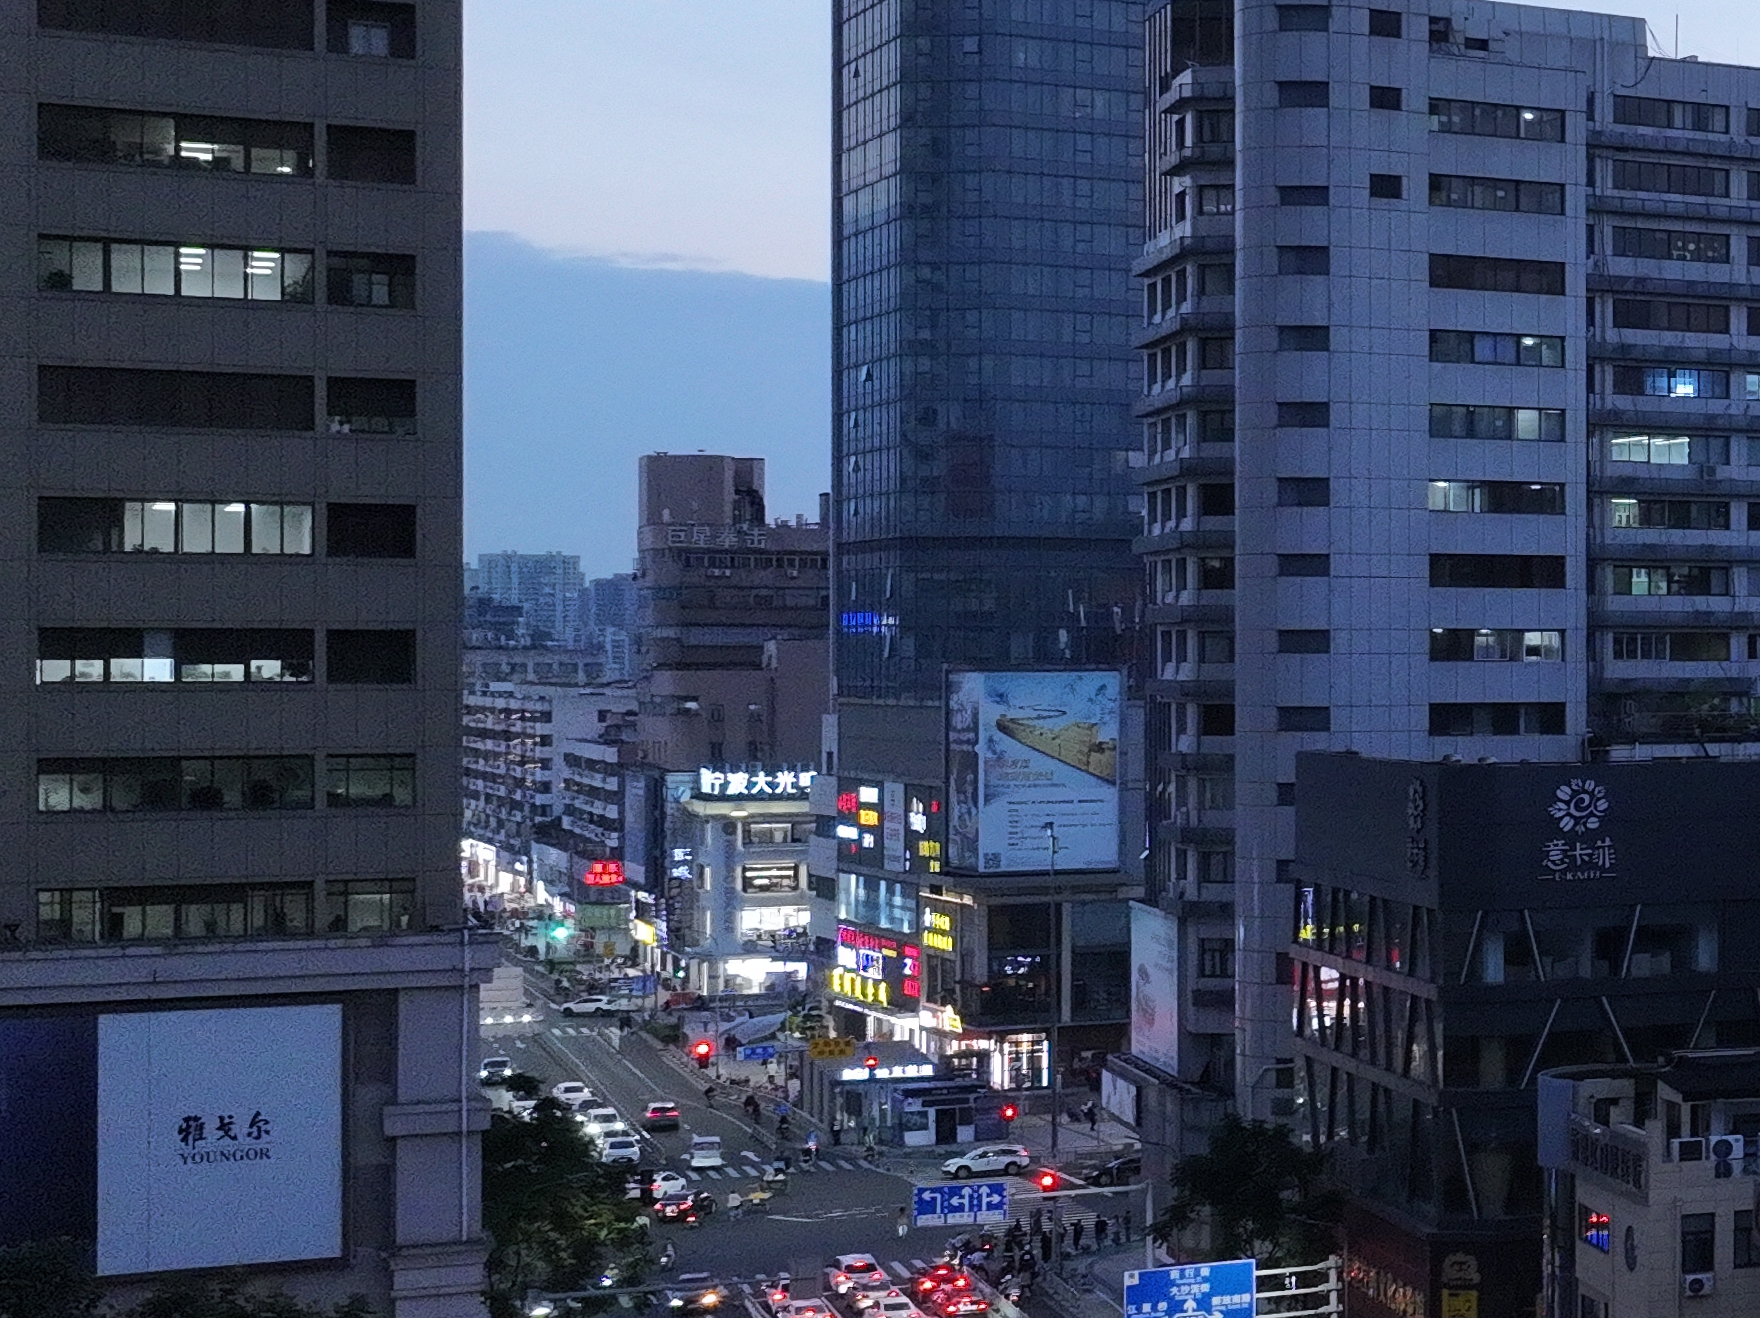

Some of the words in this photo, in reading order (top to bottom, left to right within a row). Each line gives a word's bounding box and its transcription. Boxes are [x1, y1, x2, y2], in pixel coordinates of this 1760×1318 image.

[177, 1110, 270, 1150] 雅戈尔
[177, 1147, 271, 1165] YOUNGOR
